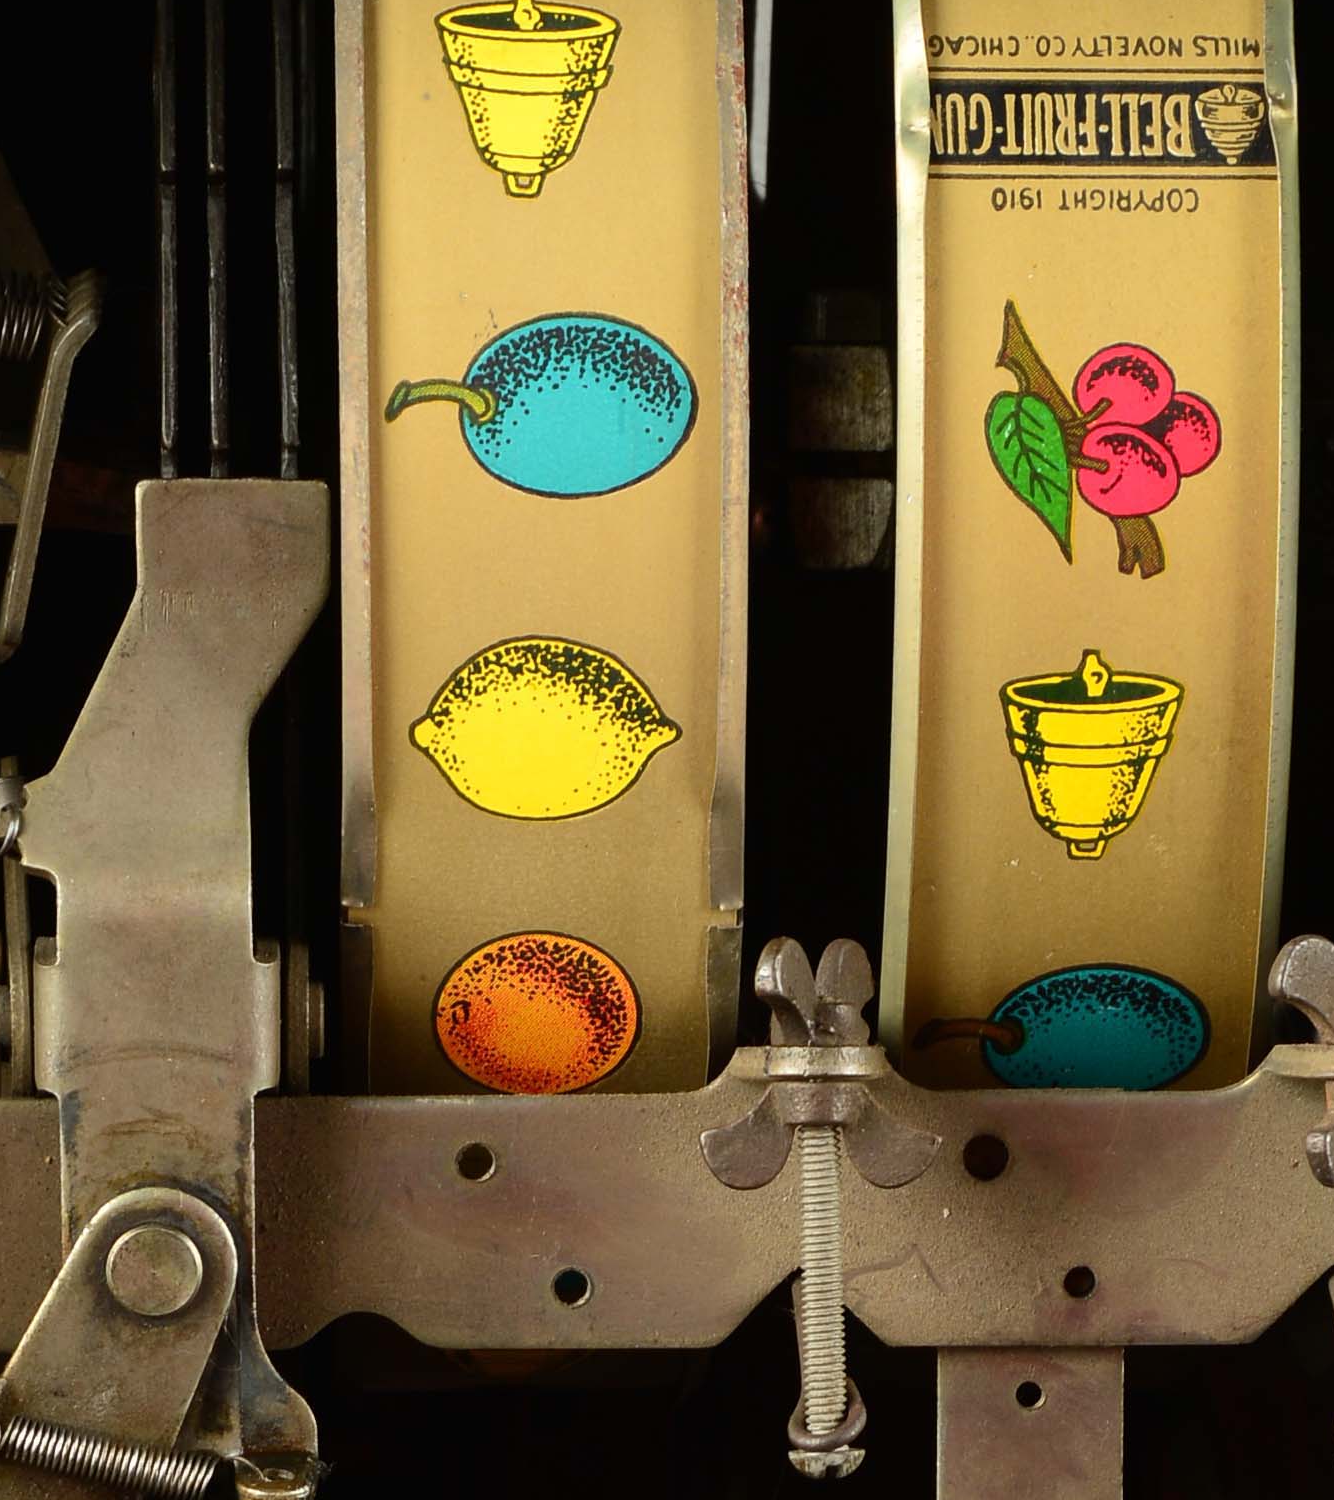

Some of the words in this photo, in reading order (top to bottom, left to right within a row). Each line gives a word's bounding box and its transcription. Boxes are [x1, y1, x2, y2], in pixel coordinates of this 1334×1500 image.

[929, 35, 1020, 58] CHICAG
[1072, 35, 1182, 58] NOVELTY
[1193, 35, 1260, 58] MILLS
[991, 187, 1042, 211] 1910
[1058, 187, 1199, 213] COPYRIGHT
